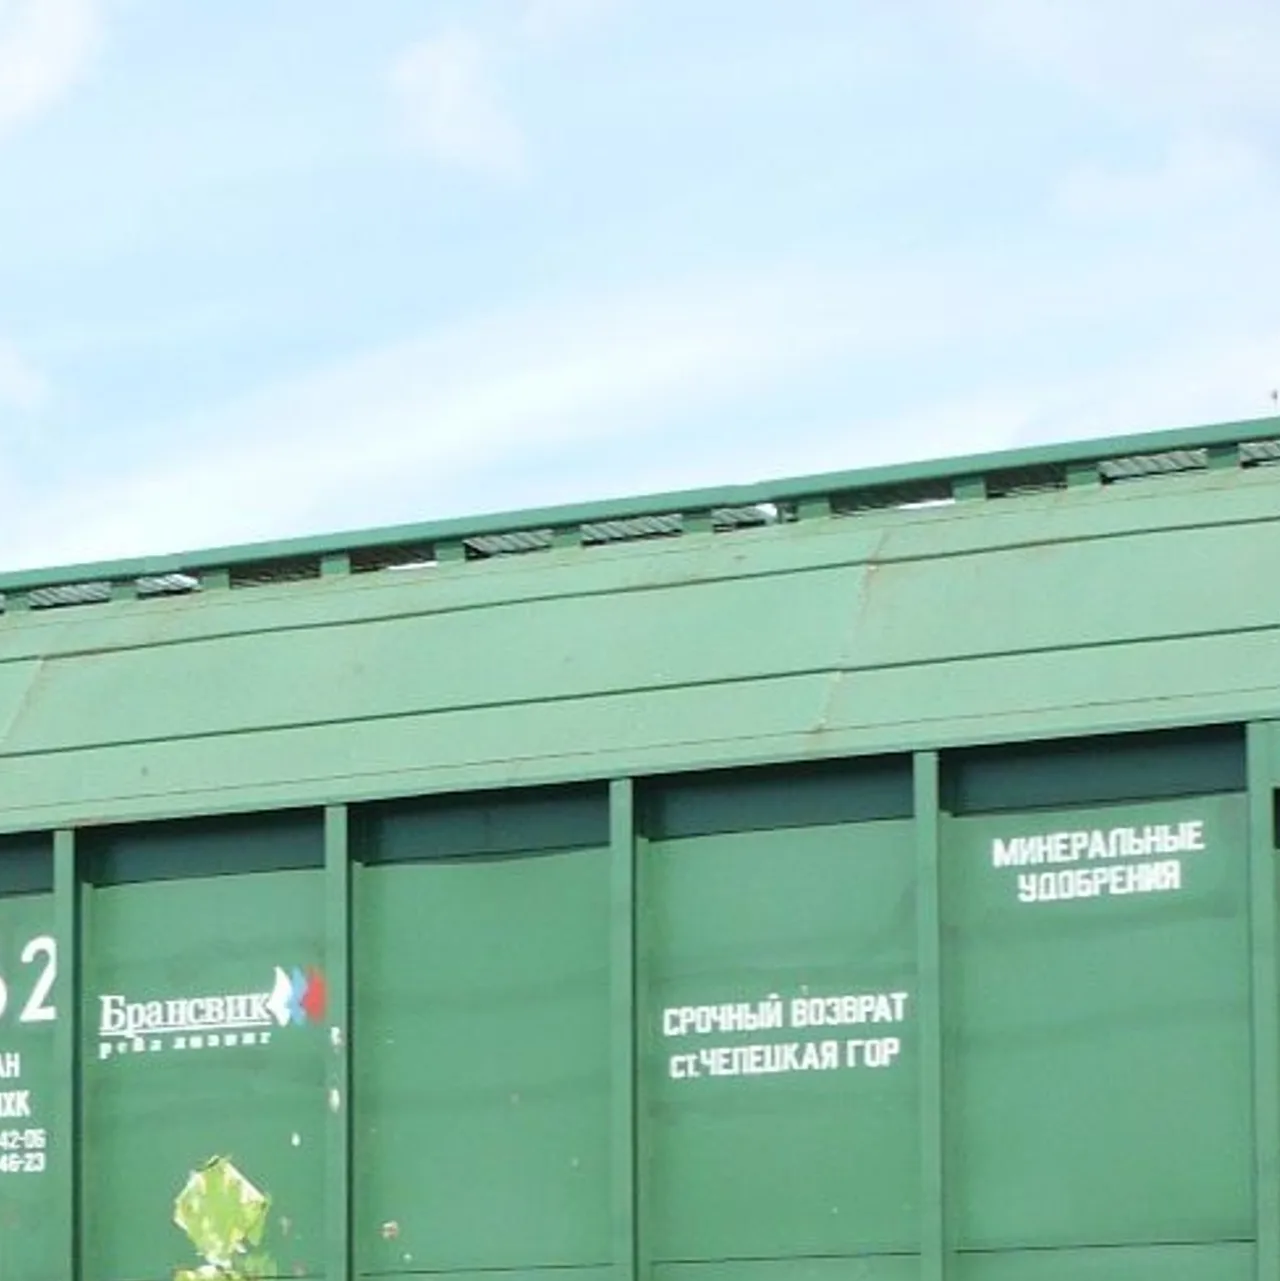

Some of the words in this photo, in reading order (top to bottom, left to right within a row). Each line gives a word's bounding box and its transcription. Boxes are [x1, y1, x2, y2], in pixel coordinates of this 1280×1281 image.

[992, 820, 1205, 868] МИНЕРАЛЬНЫЕ
[1017, 859, 1181, 903] УДОБРЕНИЯ
[99, 992, 272, 1038] Брансвик
[663, 993, 783, 1036] СРОЧНЫЙ
[790, 992, 909, 1027] ВОЗВРАТ
[847, 1037, 900, 1067] ГОР
